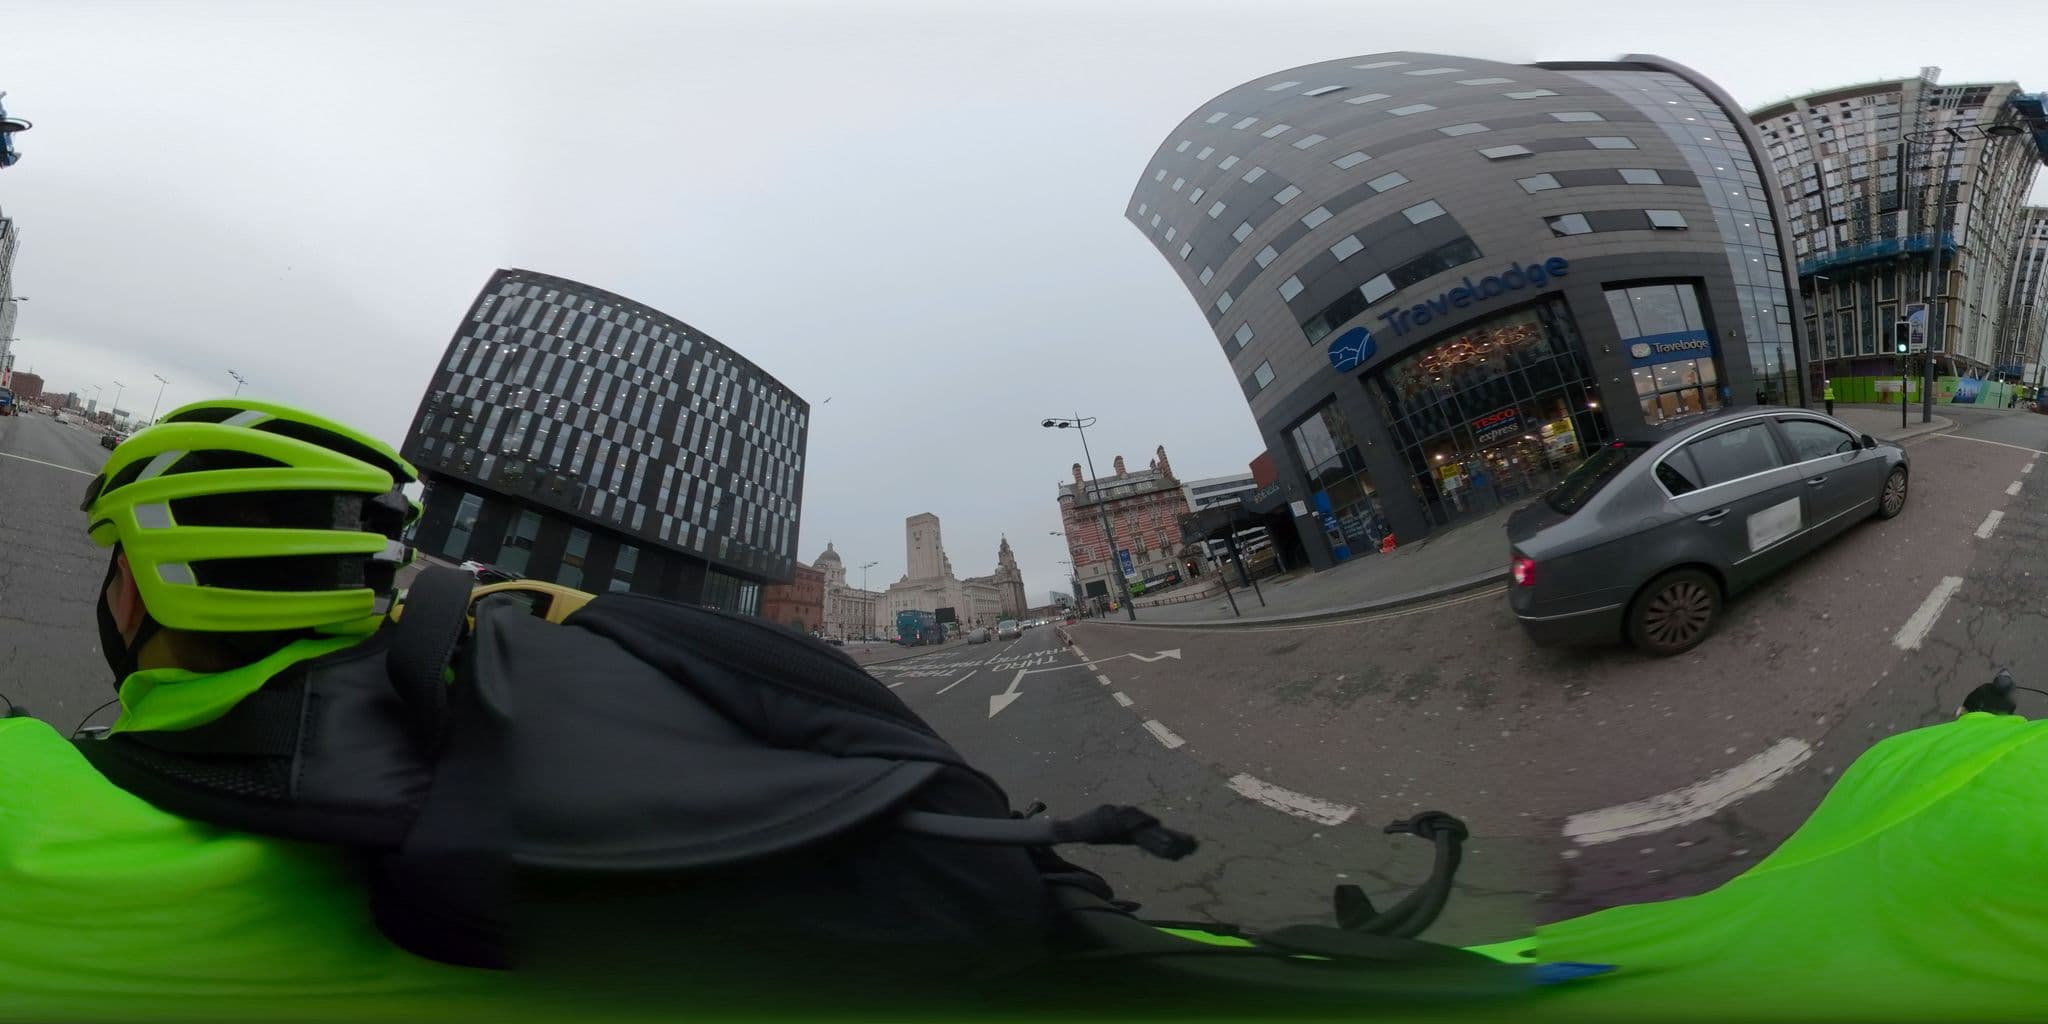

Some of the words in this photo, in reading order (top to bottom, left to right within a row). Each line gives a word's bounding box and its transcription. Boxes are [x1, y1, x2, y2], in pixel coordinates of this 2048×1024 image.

[1378, 257, 1569, 336] Travelodge
[1652, 339, 1710, 353] Travelodge
[1472, 408, 1515, 429] TESCO
[1479, 422, 1519, 442] express
